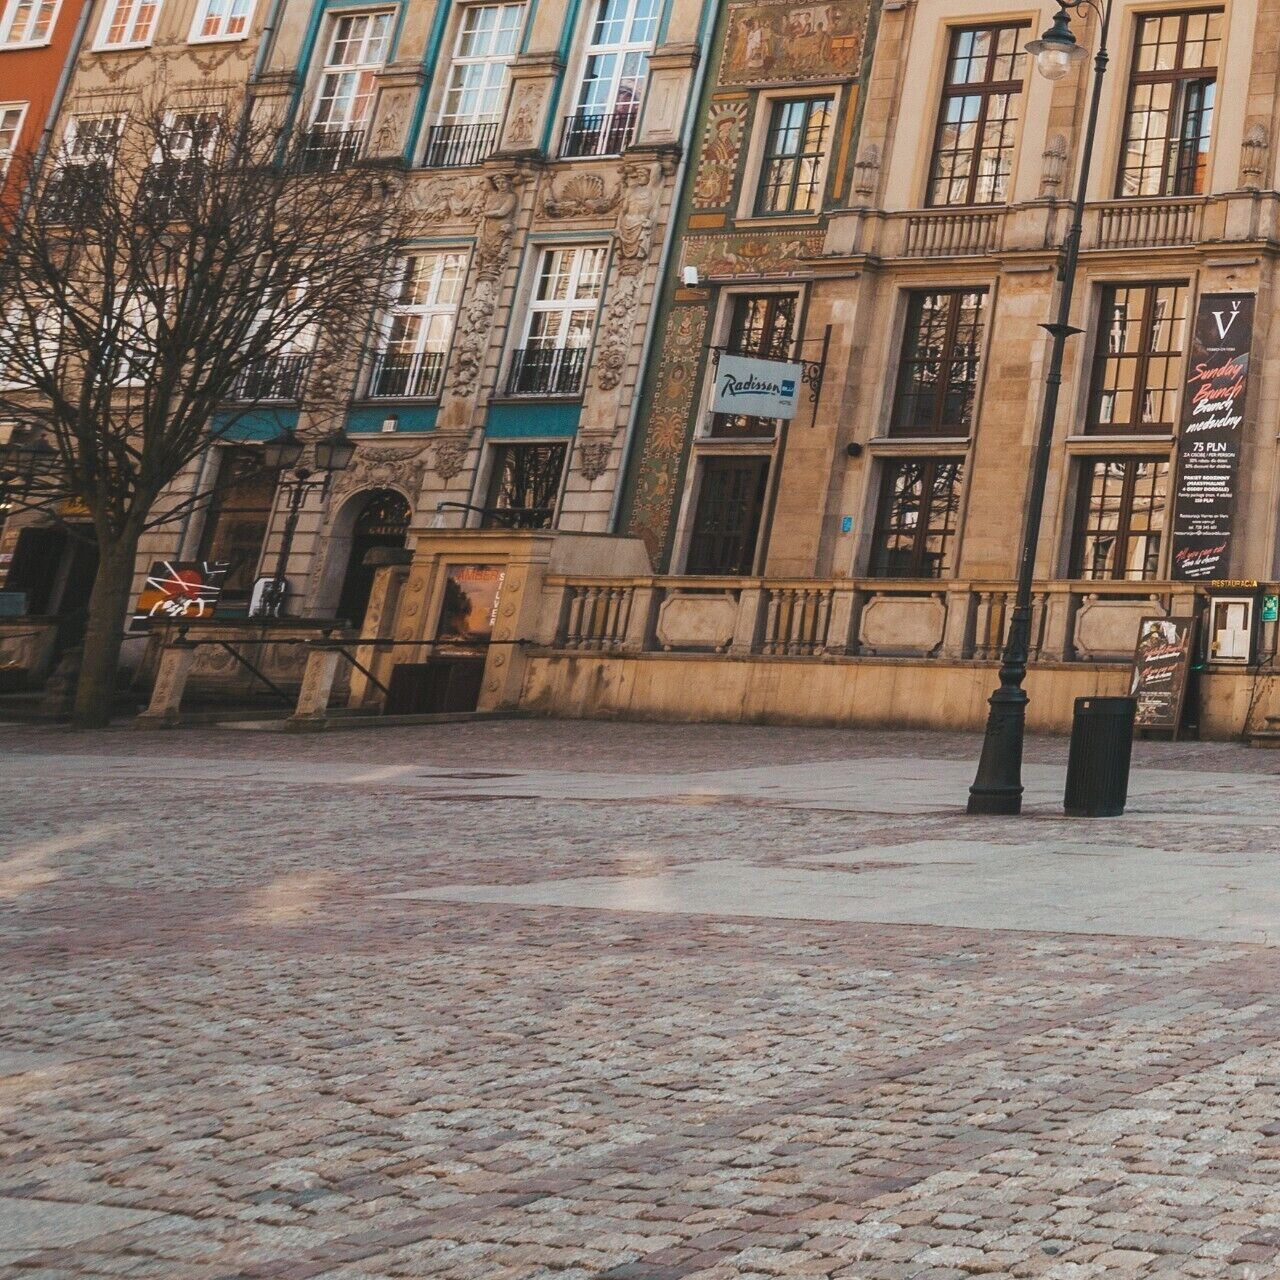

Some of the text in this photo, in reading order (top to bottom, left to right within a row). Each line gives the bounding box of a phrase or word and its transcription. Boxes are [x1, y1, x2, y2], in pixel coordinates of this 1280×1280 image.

[1187, 358, 1243, 383] Sunday
[721, 373, 780, 397] Radisson
[1192, 375, 1244, 404] Brunch
[1193, 394, 1234, 415] Brunch
[1193, 442, 1227, 452] 75 PLN
[489, 572, 505, 626] SILVER
